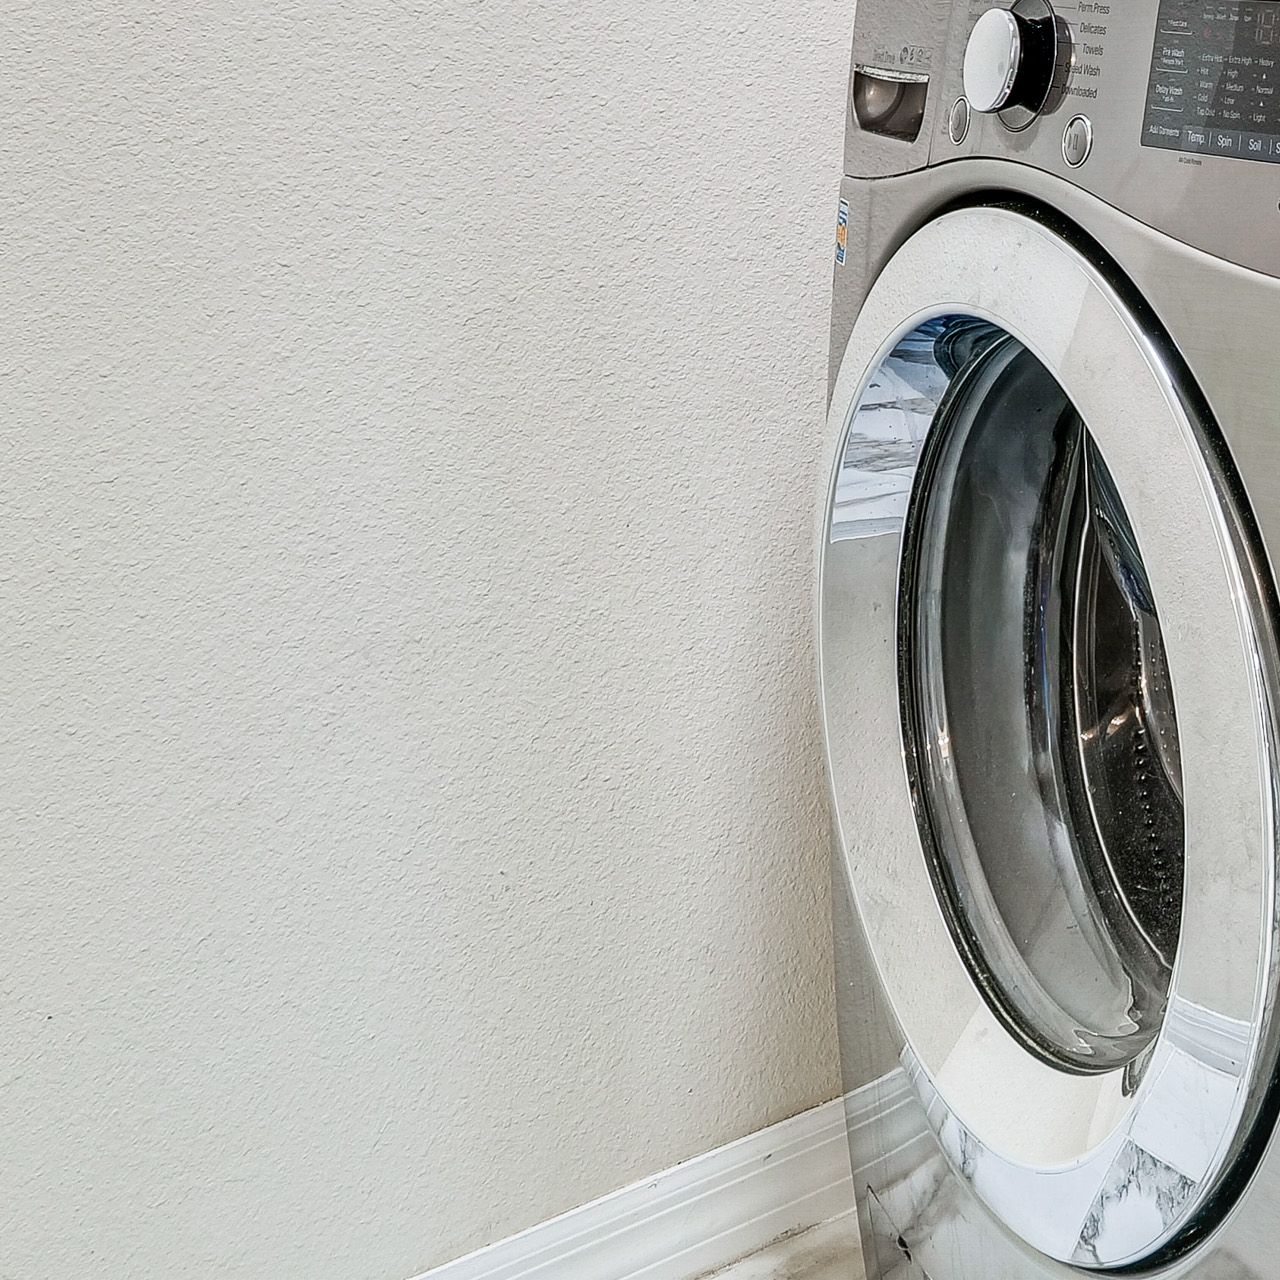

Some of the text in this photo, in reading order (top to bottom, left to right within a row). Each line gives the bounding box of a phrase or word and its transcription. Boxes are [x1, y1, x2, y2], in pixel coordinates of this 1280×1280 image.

[1080, 22, 1107, 36] Delicates
[1082, 43, 1104, 56] Towels
[1083, 64, 1101, 77] Wash
[1061, 83, 1097, 99] Downloaded
[1256, 85, 1274, 95] Normal
[1217, 135, 1232, 148] Spin
[1249, 138, 1262, 151] Soil
